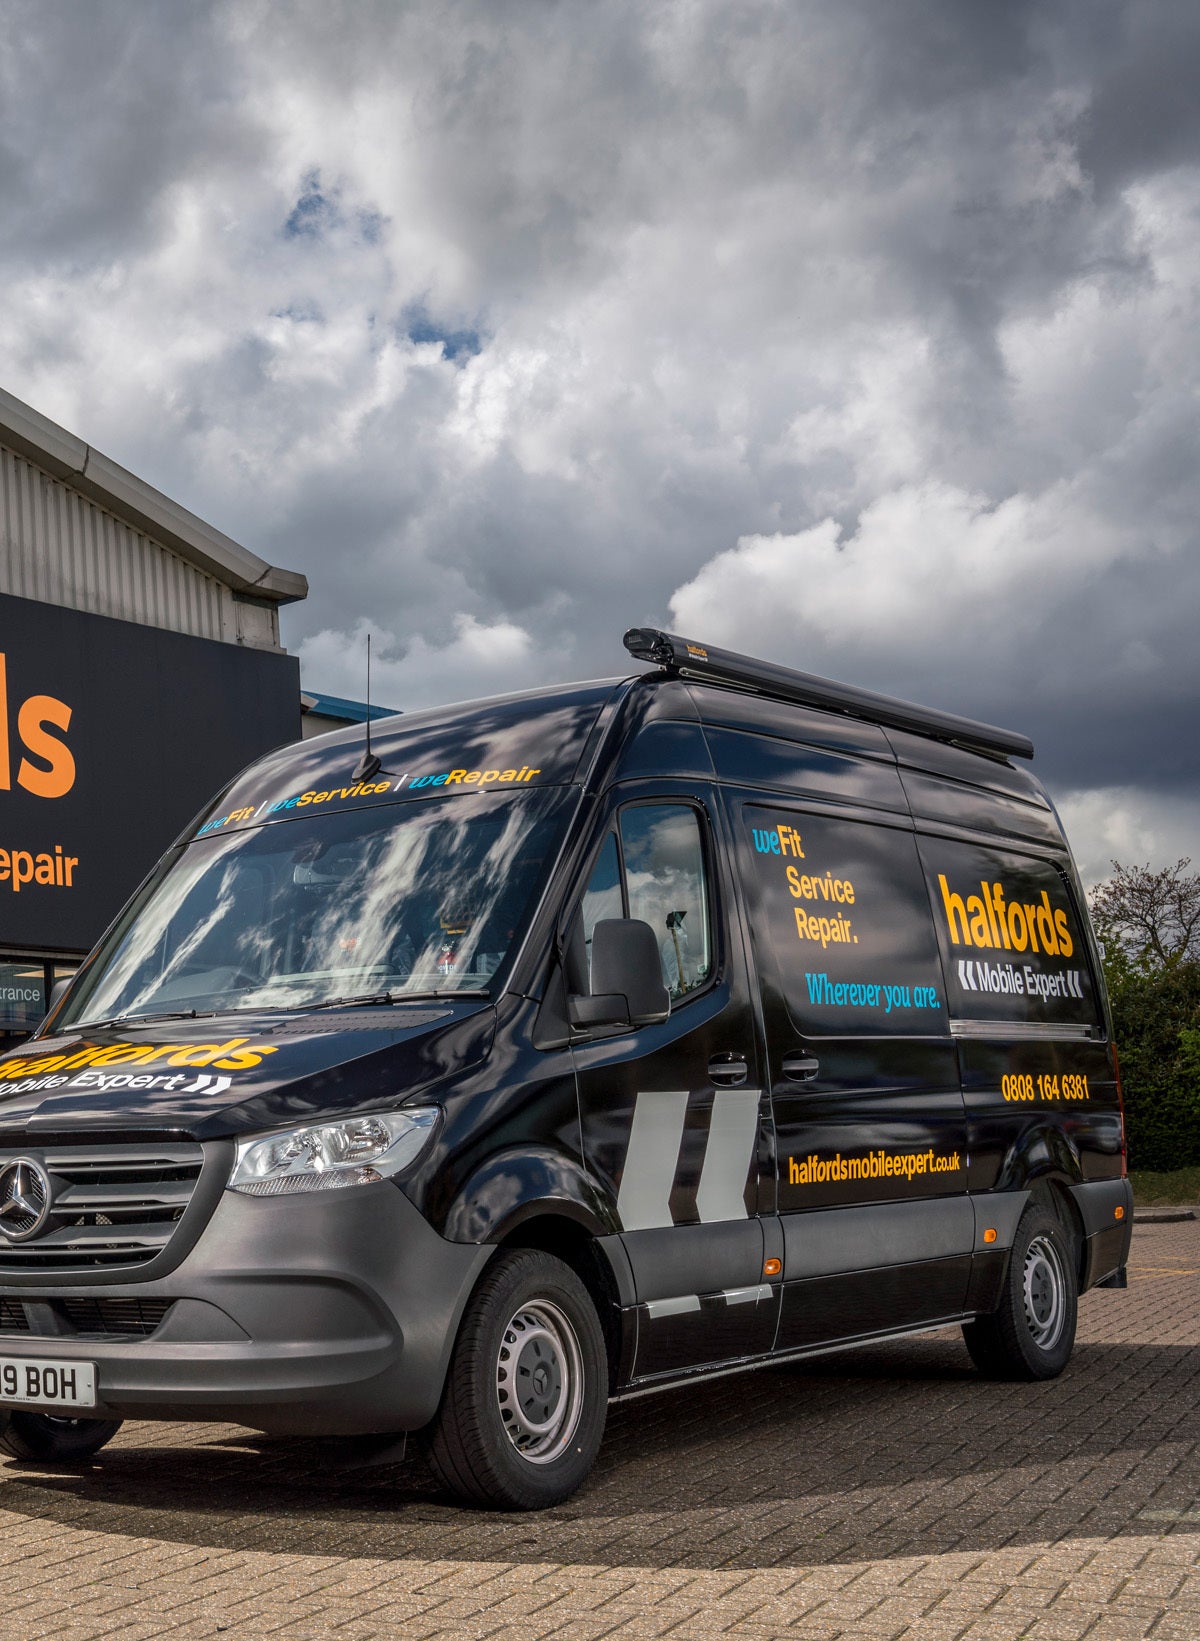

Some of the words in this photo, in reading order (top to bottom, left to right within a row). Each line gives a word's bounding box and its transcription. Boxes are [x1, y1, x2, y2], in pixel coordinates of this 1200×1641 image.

[198, 806, 254, 835] weFit
[265, 780, 390, 813] weService
[409, 767, 541, 790] weRepair
[752, 825, 806, 858] weFit
[786, 866, 855, 904] Service
[794, 907, 858, 948] Repair.
[938, 874, 1073, 957] halfords
[805, 973, 881, 1008] Wherever
[883, 984, 912, 1014] you
[913, 986, 941, 1009] are.
[976, 962, 1023, 995] Mobile
[1023, 965, 1068, 1002] Expert
[67, 1071, 187, 1092] Expert
[1002, 1075, 1034, 1101] 0808
[1037, 1075, 1060, 1100] 164
[1062, 1075, 1090, 1100] 6381
[789, 1149, 961, 1184] halfordsmobileexpert.co.uk
[25, 1366, 77, 1400] BOH
